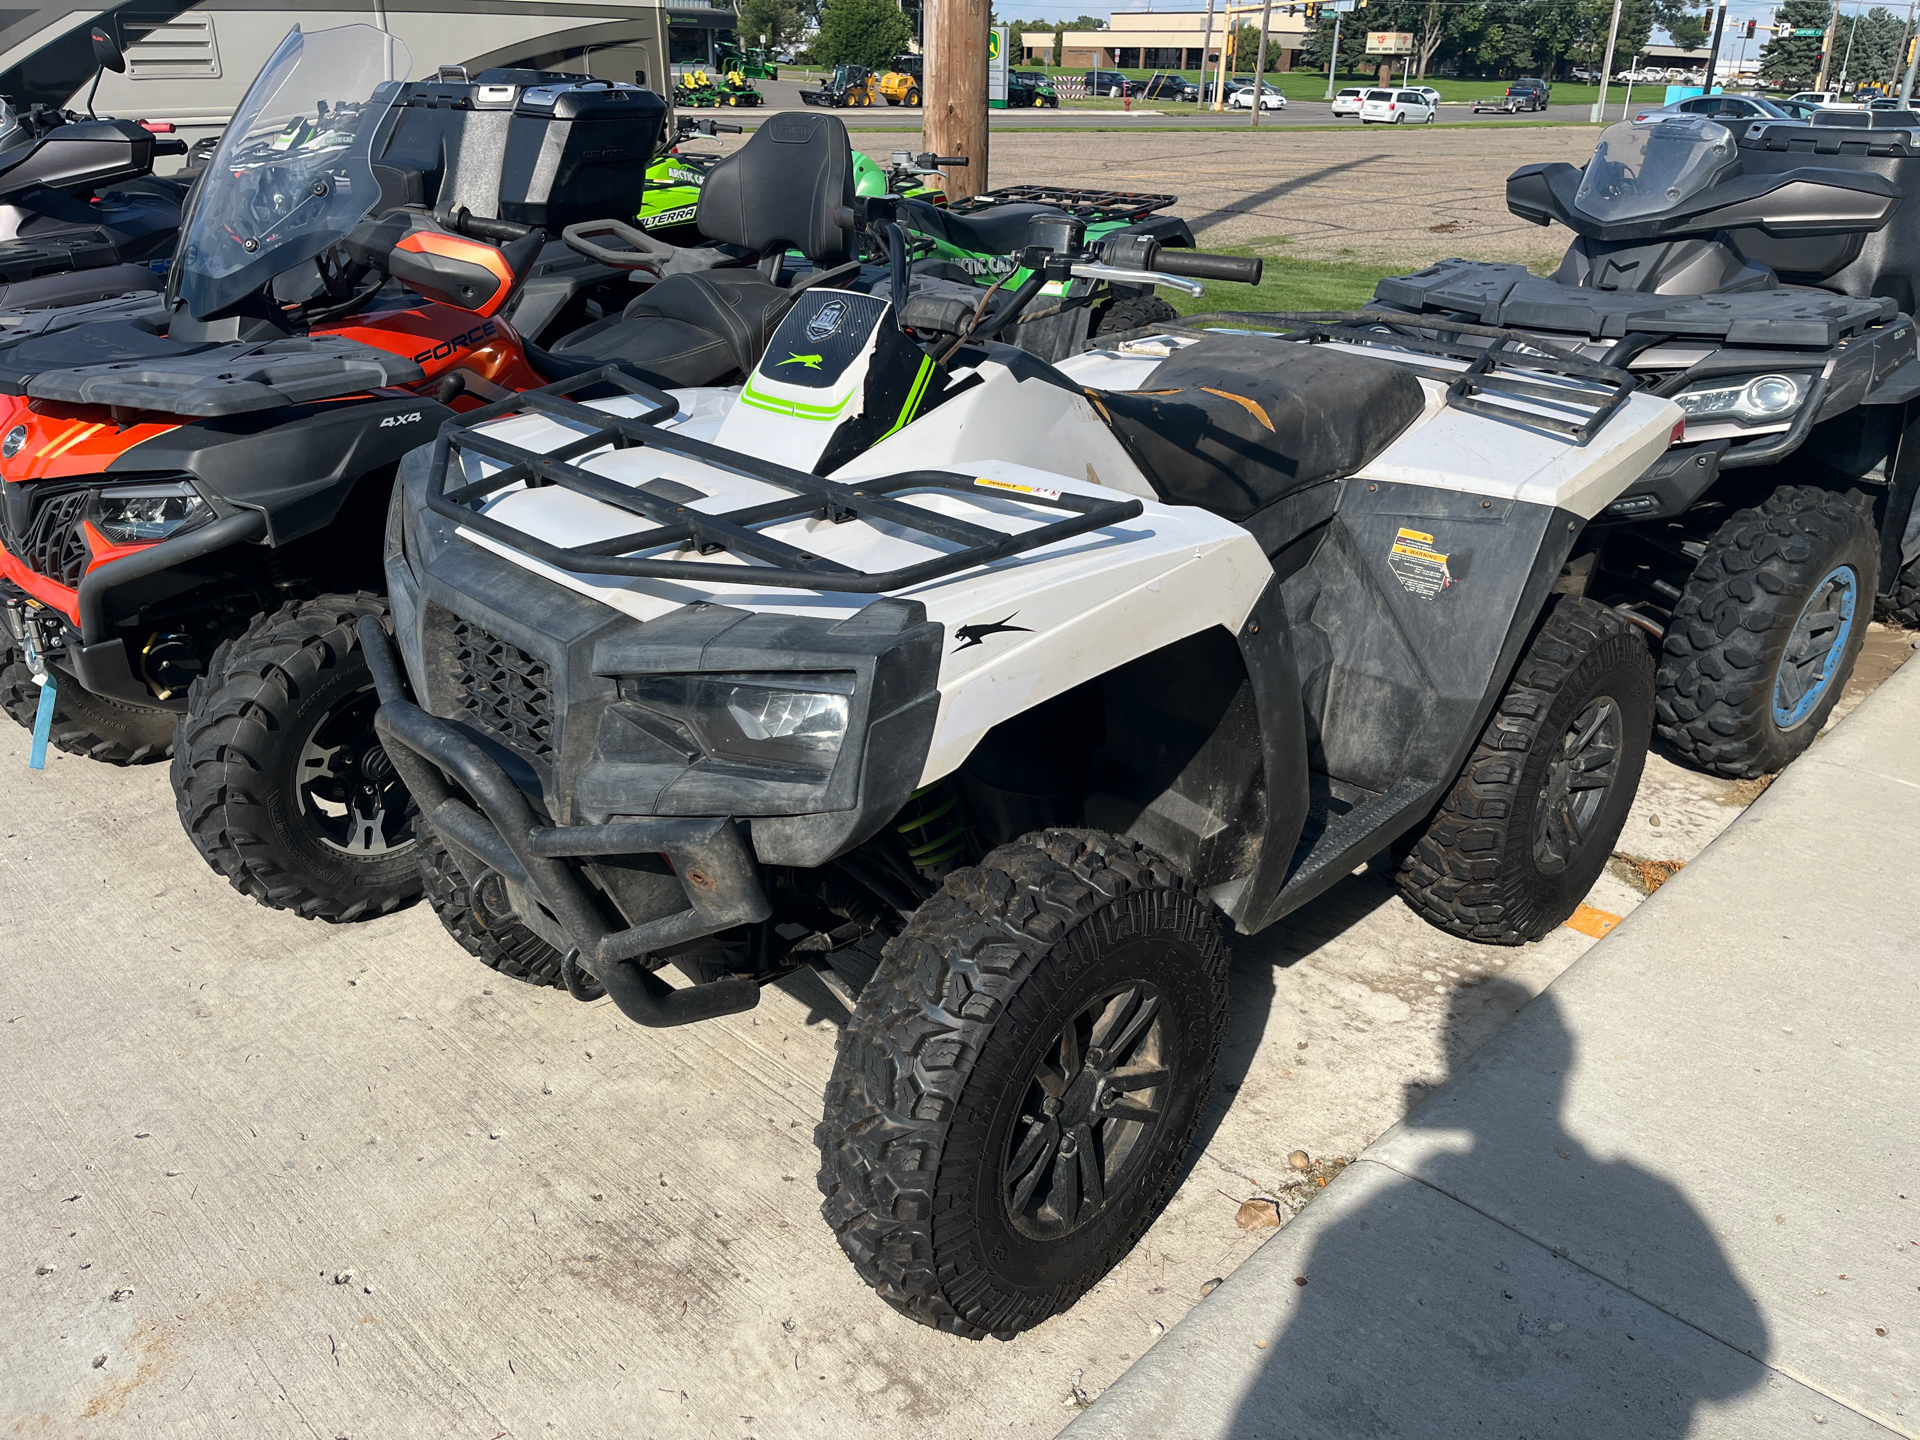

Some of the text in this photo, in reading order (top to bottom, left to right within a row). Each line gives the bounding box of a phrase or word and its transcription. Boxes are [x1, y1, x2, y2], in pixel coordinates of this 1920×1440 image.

[668, 167, 695, 183] ARCTIC
[988, 257, 1013, 274] CAT
[407, 320, 497, 365] FORCE
[1409, 549, 1438, 560] WARNING
